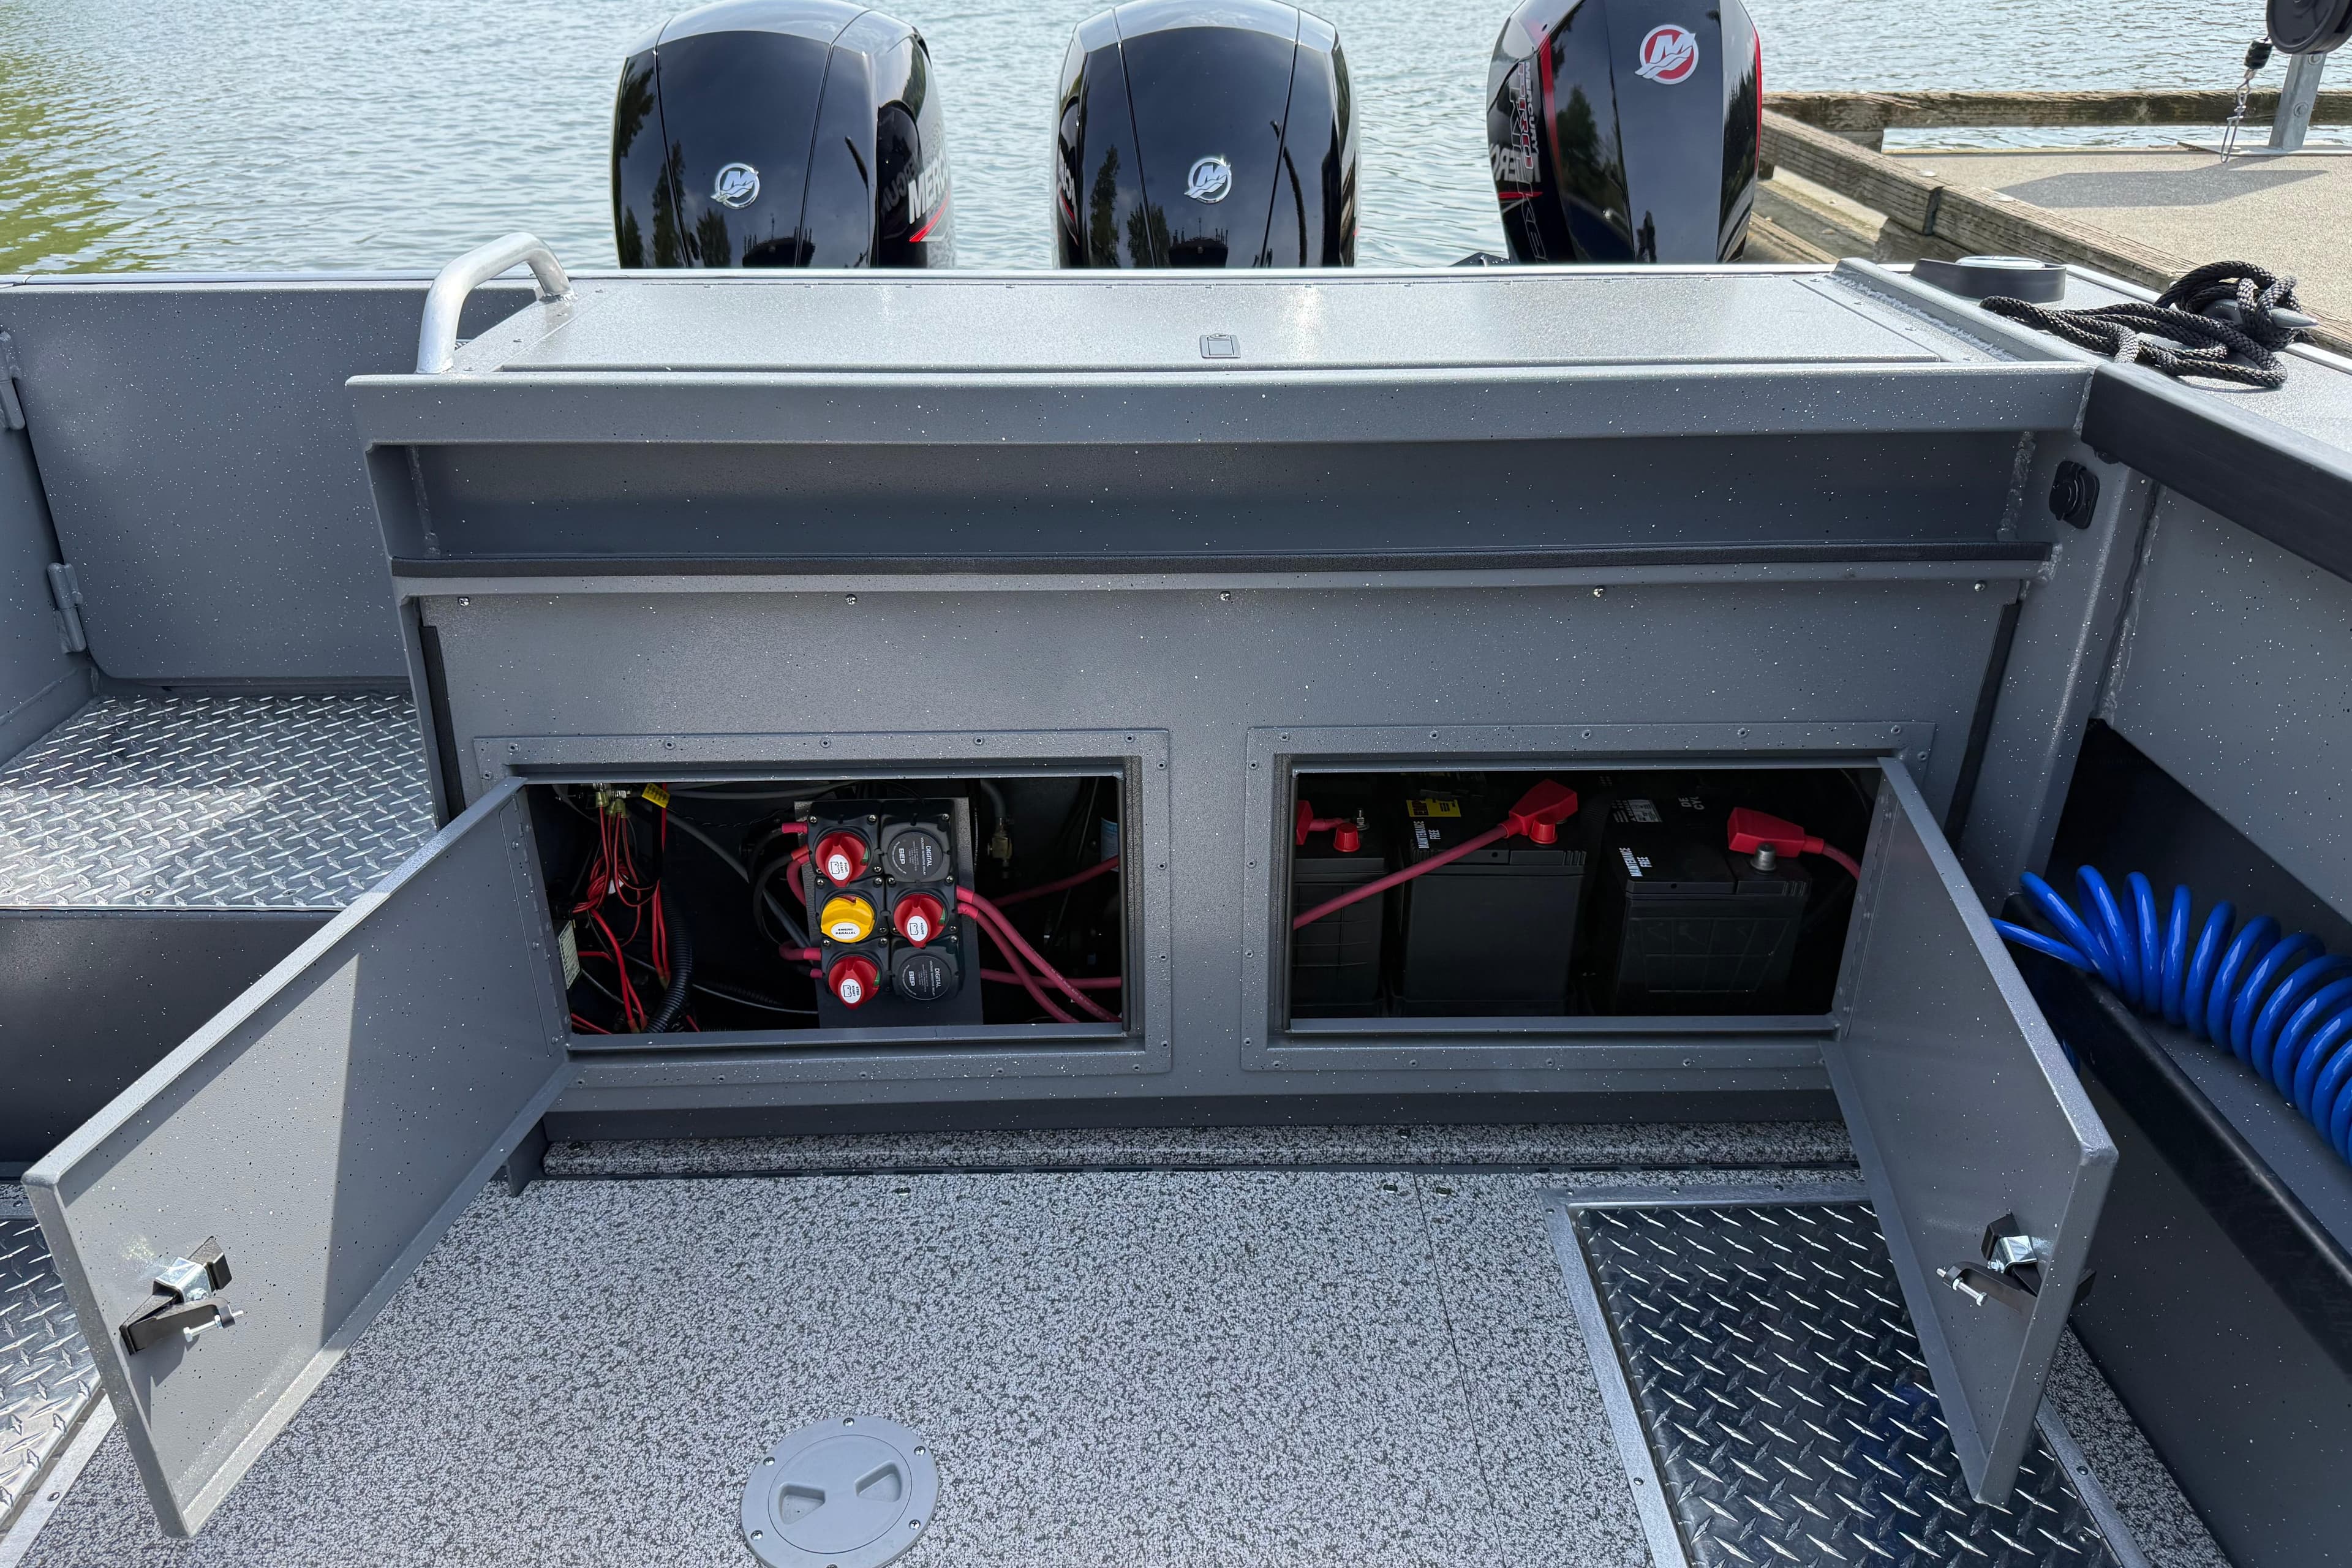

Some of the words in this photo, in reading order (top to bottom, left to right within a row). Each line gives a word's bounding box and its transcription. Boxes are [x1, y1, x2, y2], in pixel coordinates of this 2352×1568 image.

[1518, 61, 1533, 168] PRO
[1525, 61, 1539, 154] MERCURY
[1413, 821, 1430, 848] MAINTENANCE
[1428, 829, 1441, 840] FREE
[1619, 847, 1643, 876] MAINTENANCE
[1637, 856, 1653, 867] FREE
